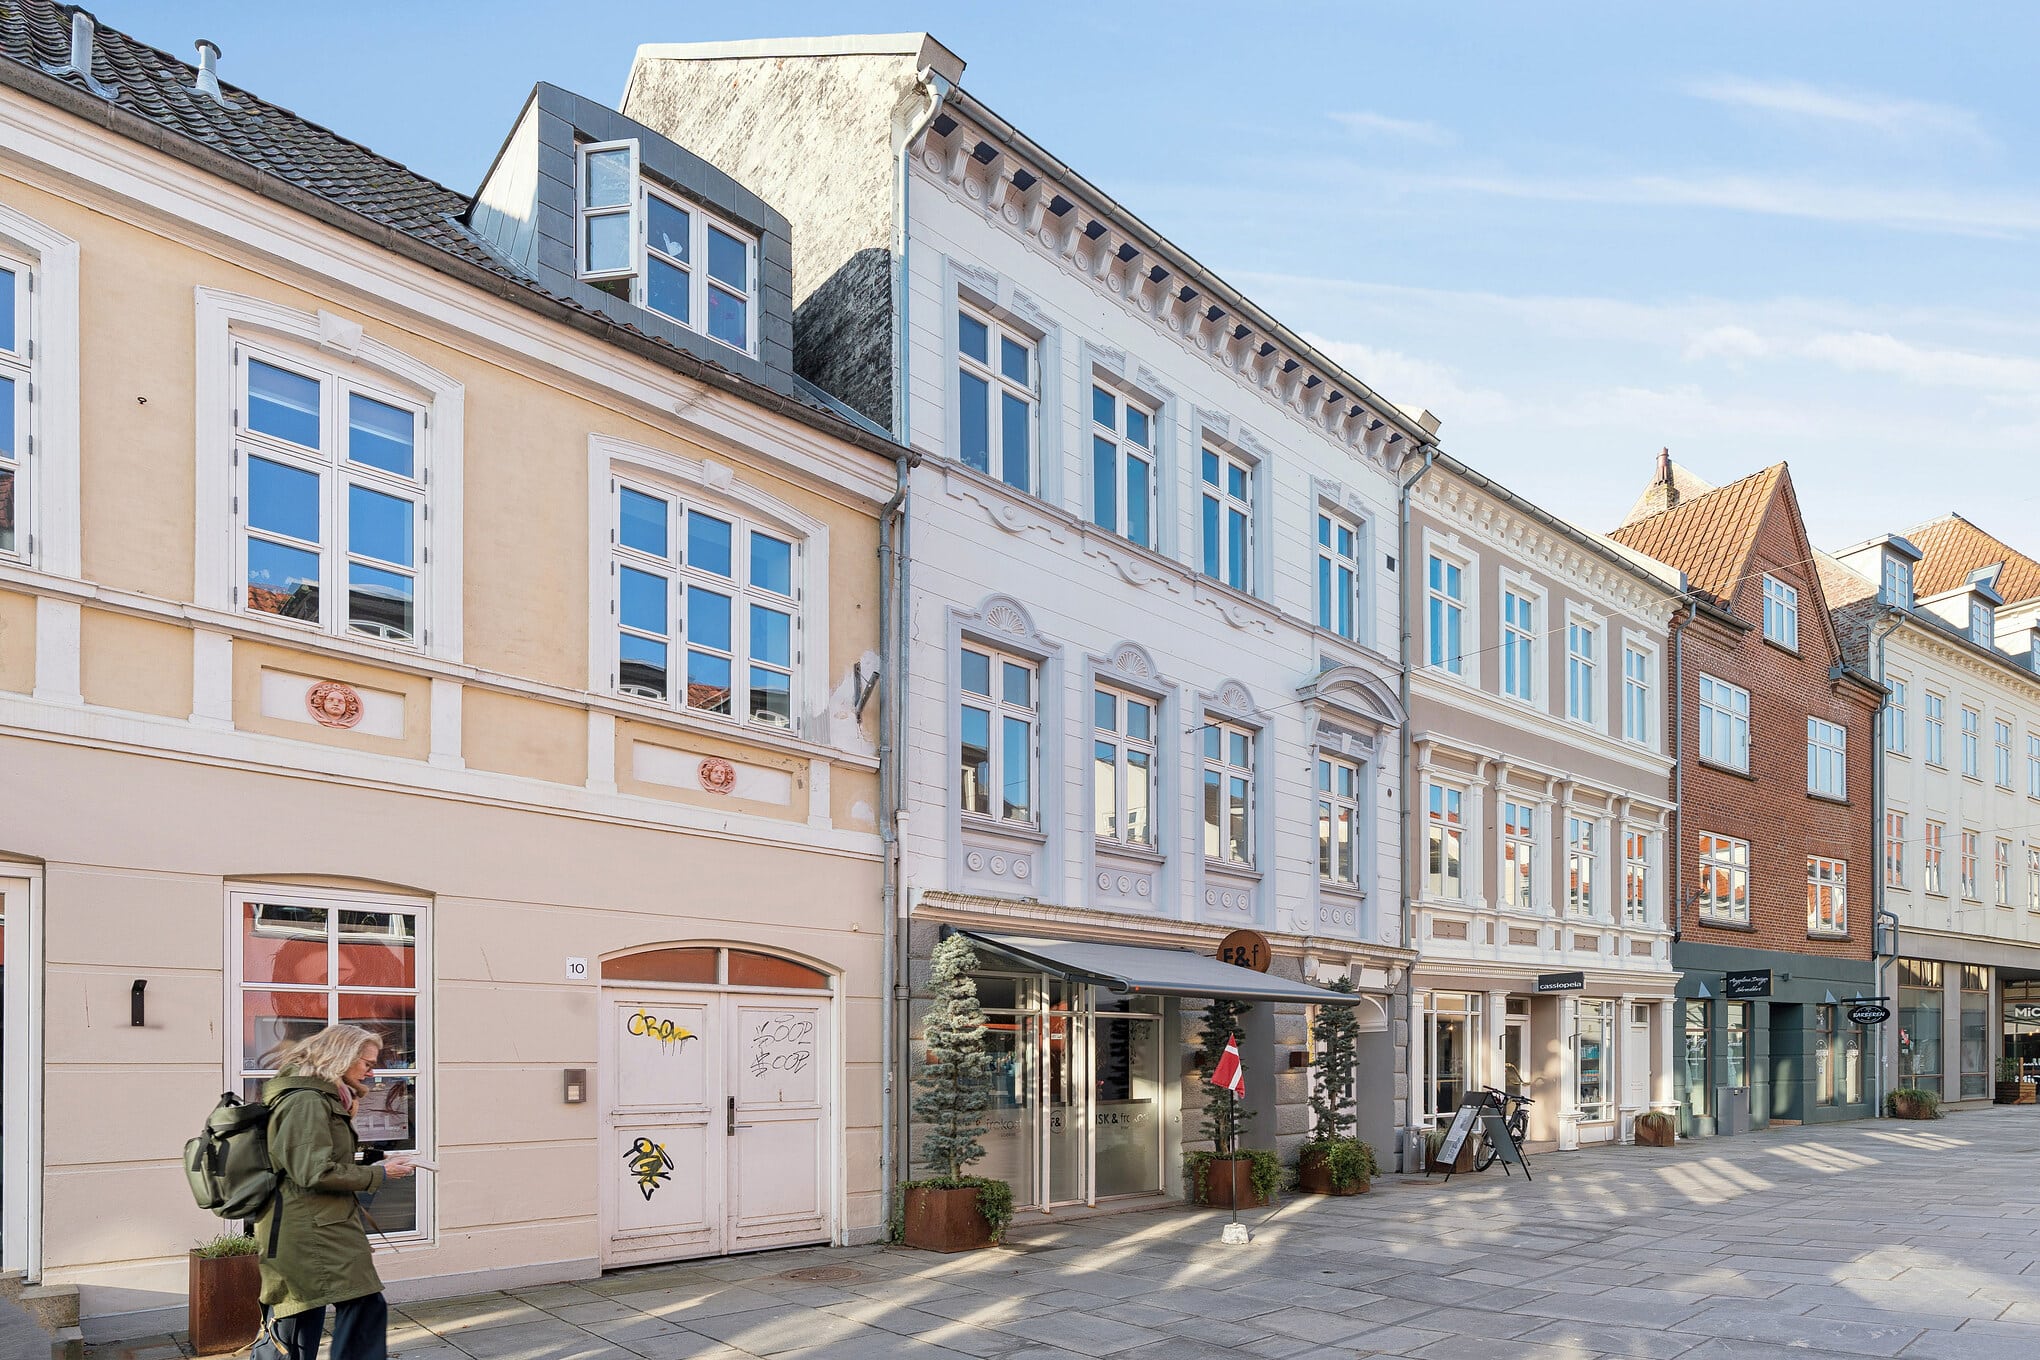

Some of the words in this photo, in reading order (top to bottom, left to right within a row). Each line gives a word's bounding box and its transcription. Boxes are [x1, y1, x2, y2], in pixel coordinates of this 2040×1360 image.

[569, 963, 585, 974] 10
[1539, 981, 1582, 990] cassiopeia
[1111, 1113, 1119, 1124] &
